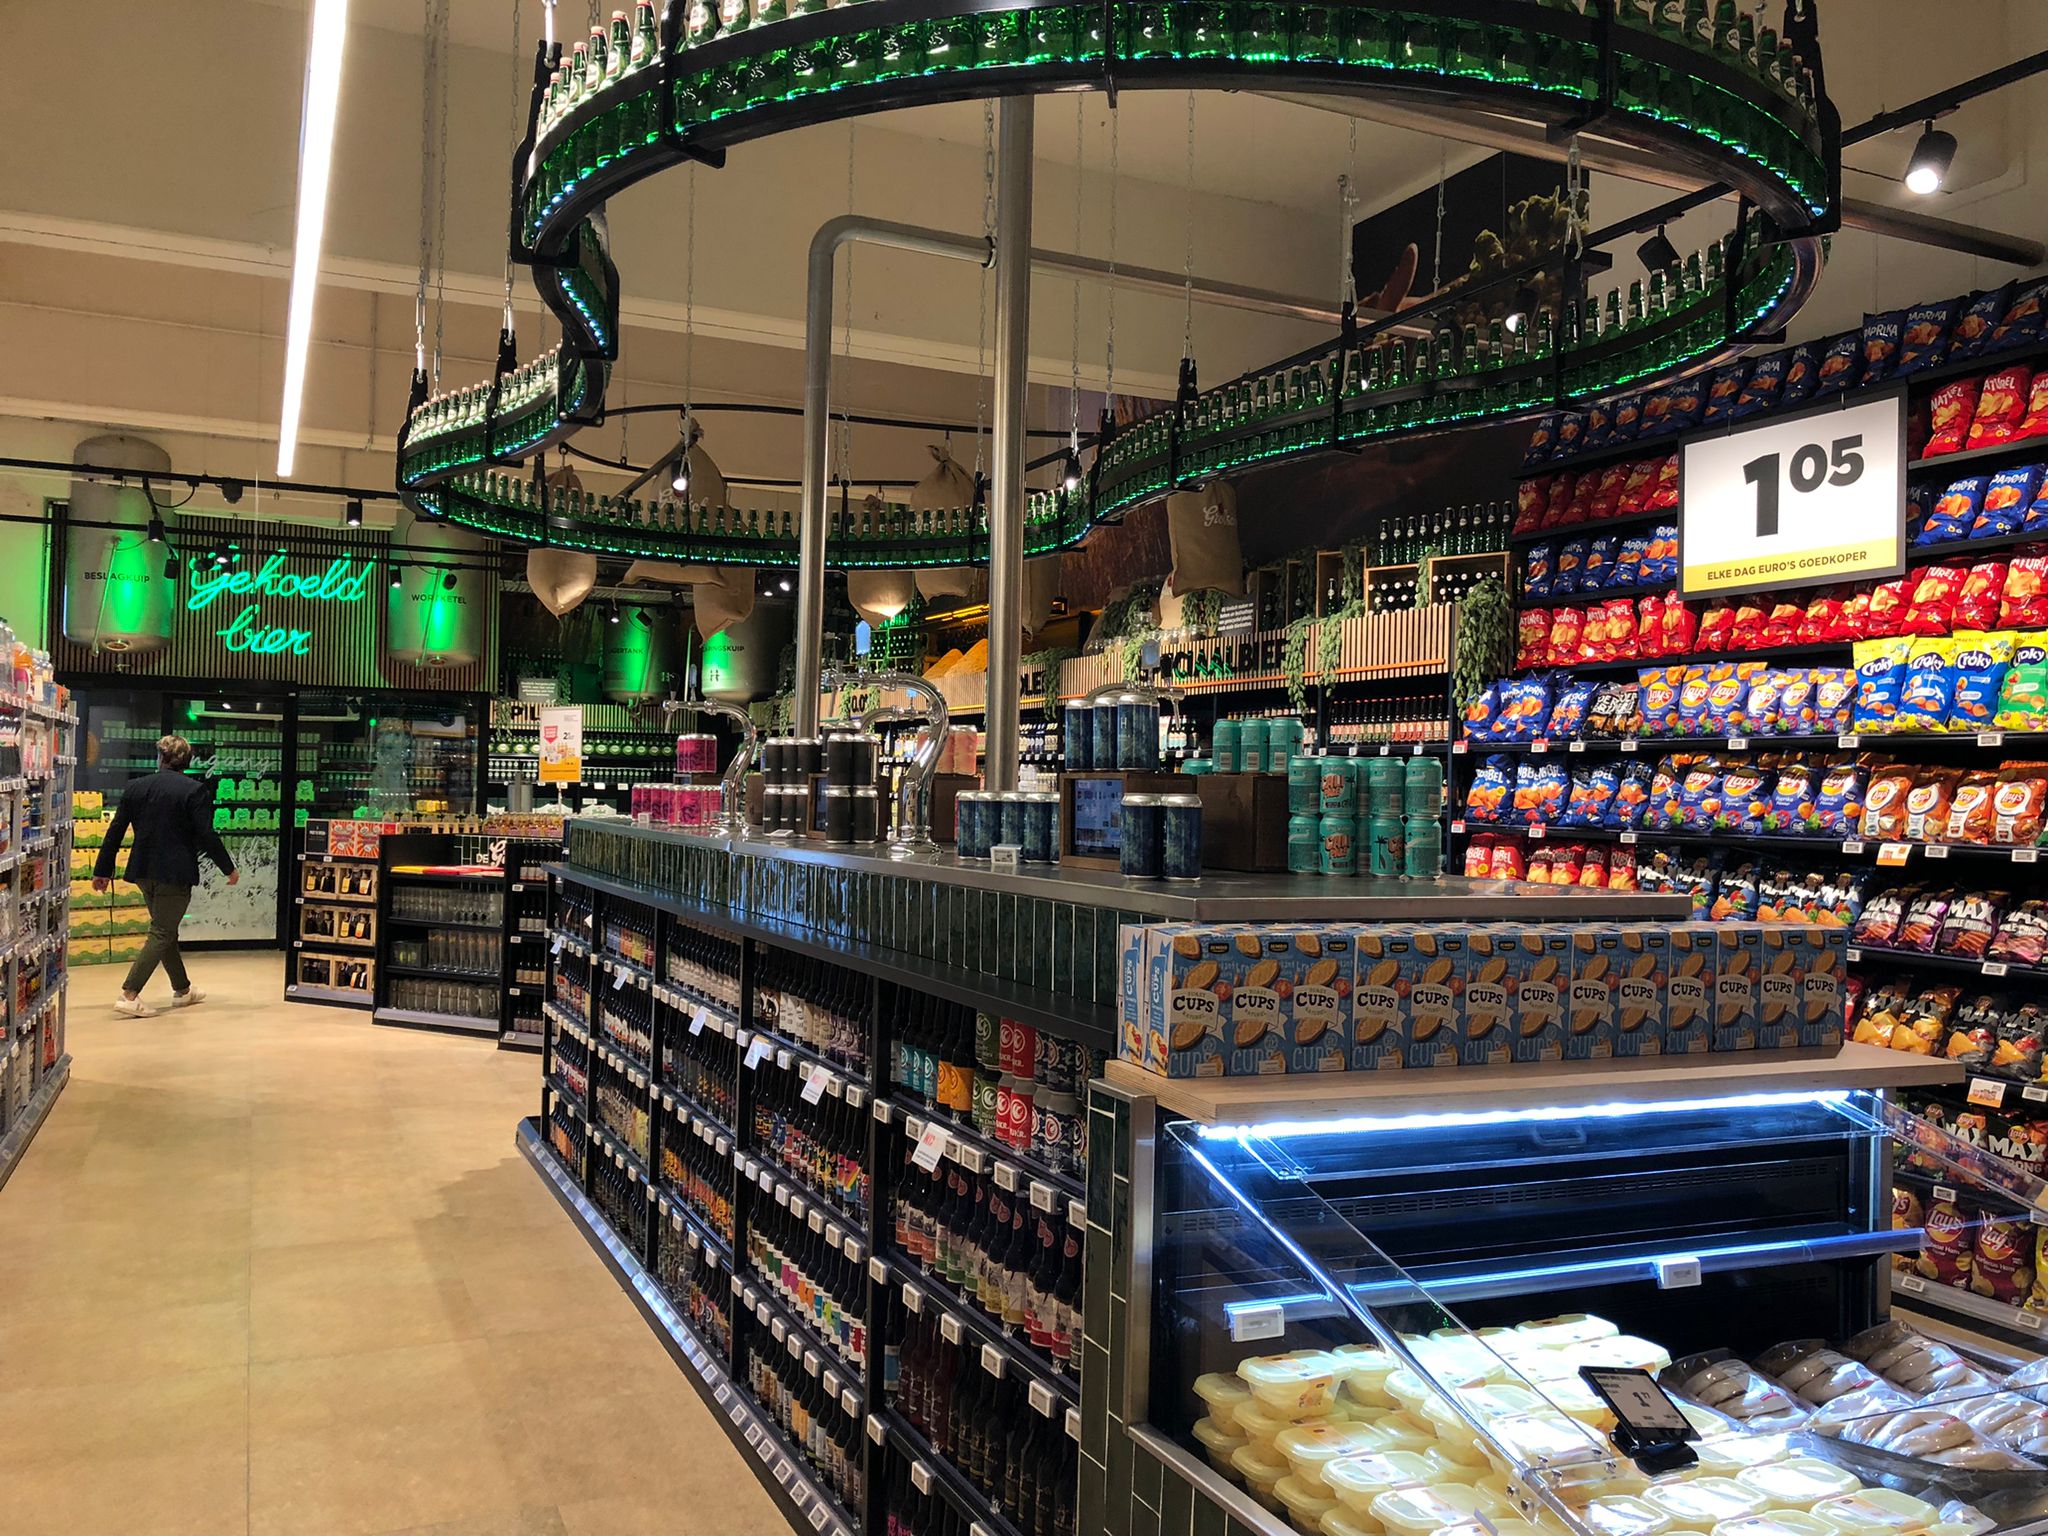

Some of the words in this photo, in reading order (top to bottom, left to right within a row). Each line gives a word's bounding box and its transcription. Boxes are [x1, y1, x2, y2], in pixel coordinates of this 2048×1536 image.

[1707, 569, 1733, 581] ELKE
[1735, 566, 1756, 577] DAG
[1758, 560, 1796, 574] EURO'S
[1799, 551, 1867, 569] GOEDKOPER
[85, 571, 150, 584] BESLAGKUIP
[216, 604, 312, 655] bier
[476, 853, 489, 864] DE
[1947, 900, 1995, 924] MAX
[1573, 986, 1606, 1001] CUPS
[1621, 984, 1654, 999] CUPS
[1671, 982, 1701, 998] CUPS
[1719, 980, 1749, 995] CUPS
[1763, 980, 1793, 994] CUPS
[1805, 978, 1835, 993] CUPS
[1235, 993, 1275, 1011] CUPS
[1296, 992, 1335, 1009] CUPS
[1357, 992, 1395, 1009] CUPS
[1413, 990, 1449, 1006] CUPS
[1468, 988, 1504, 1005] CUPS
[1521, 987, 1555, 1003] CUPS
[1173, 995, 1215, 1013] CUPS
[1989, 1135, 2046, 1161] MAX
